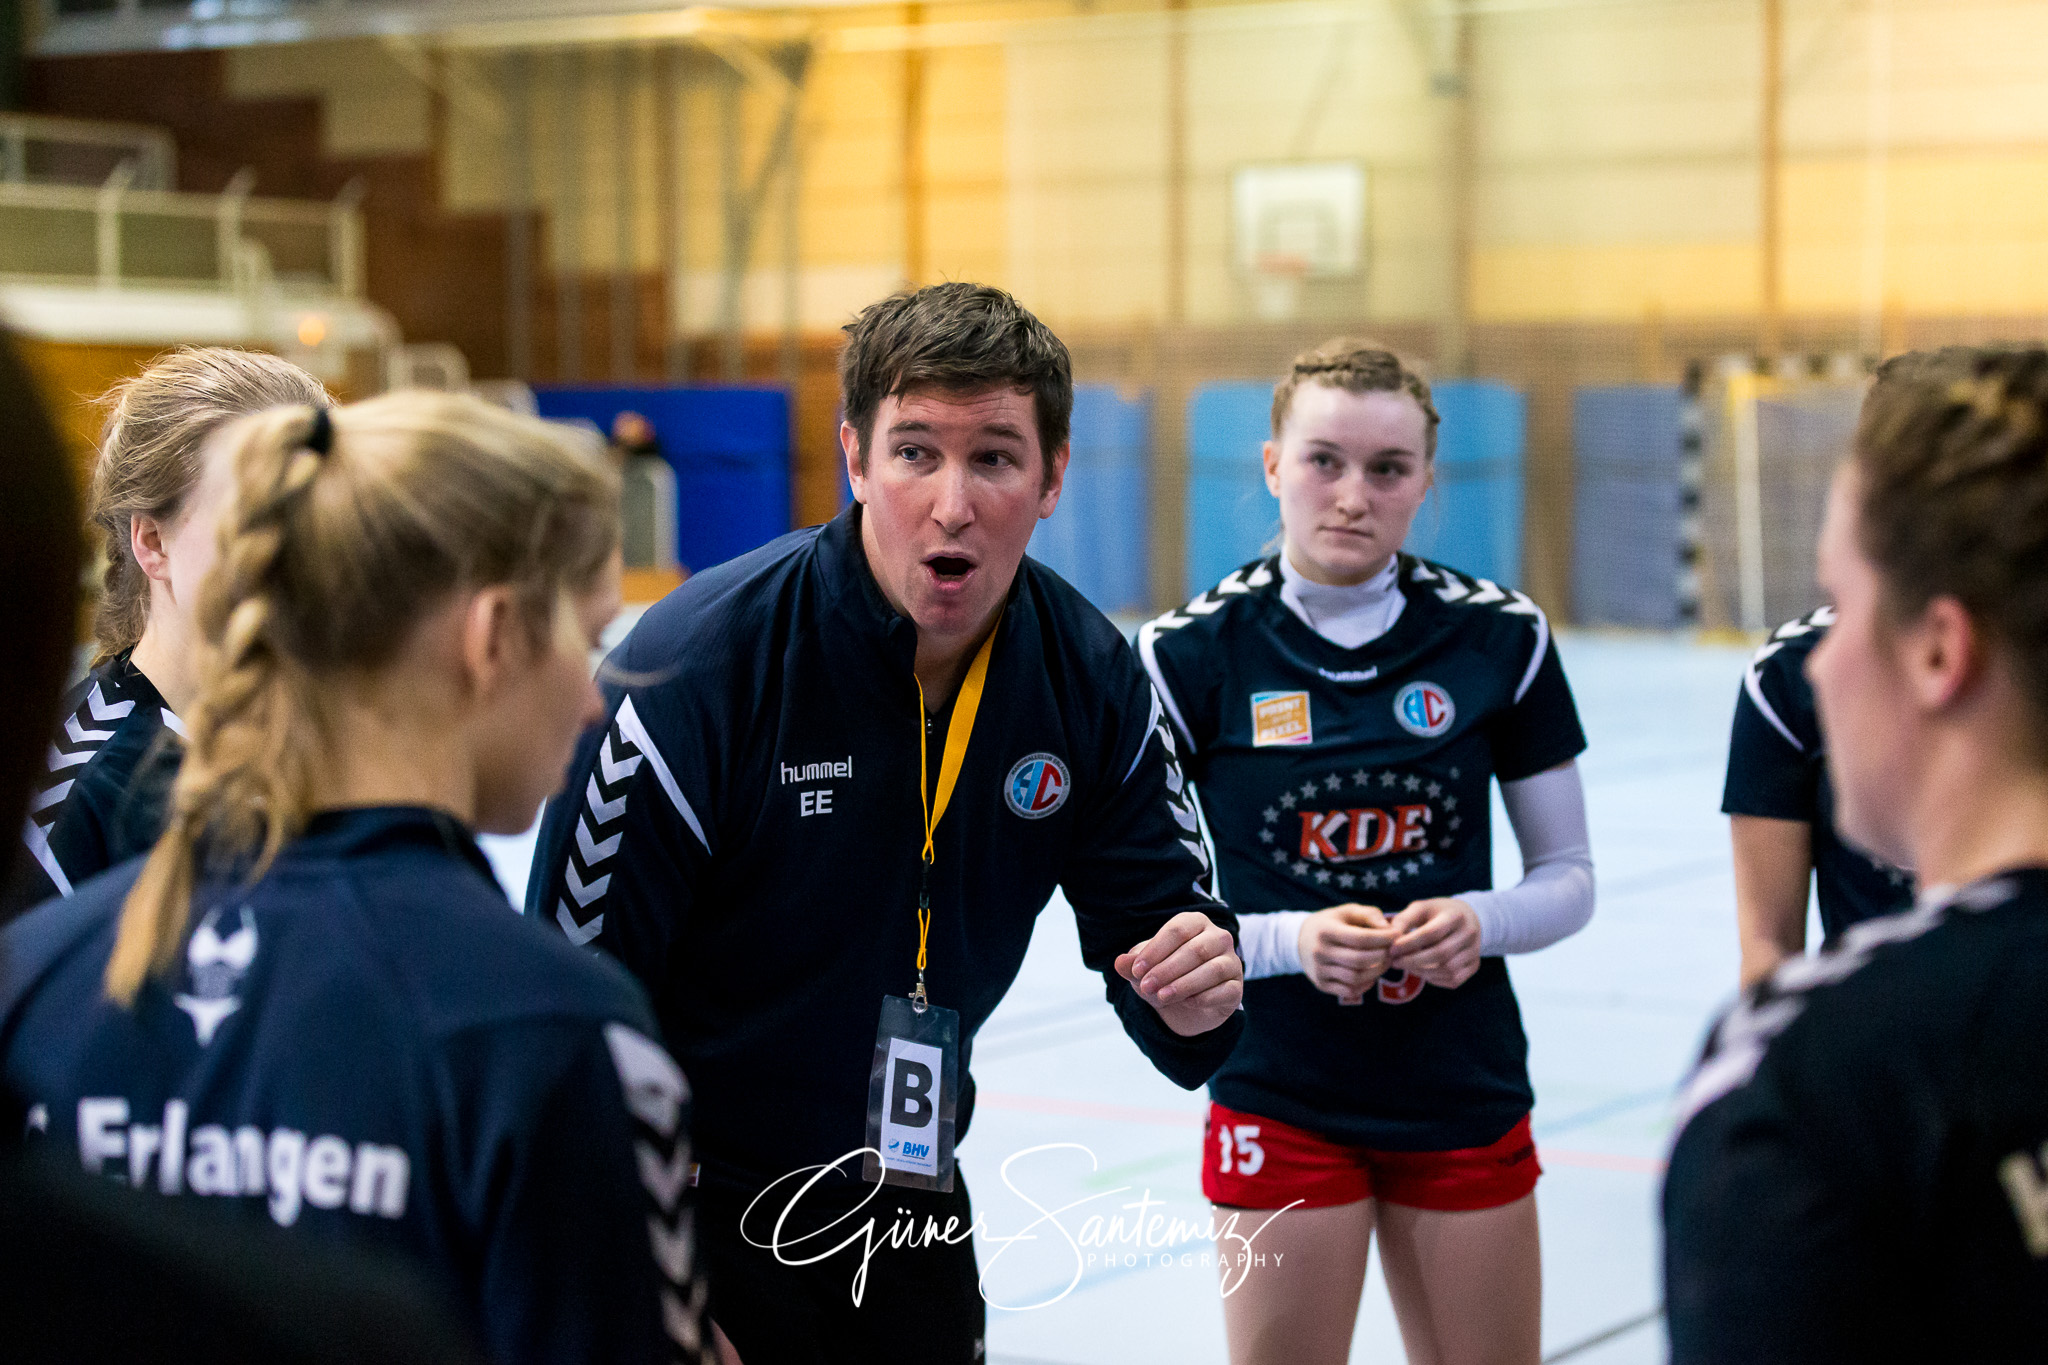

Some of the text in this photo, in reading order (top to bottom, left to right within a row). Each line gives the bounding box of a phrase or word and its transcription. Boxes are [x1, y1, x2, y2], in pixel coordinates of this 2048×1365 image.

[780, 755, 853, 785] hummel
[800, 789, 834, 817] EE
[1298, 804, 1432, 864] KDE
[889, 1057, 933, 1128] B
[77, 1096, 411, 1227] Erlangen
[902, 1141, 930, 1158] BHV
